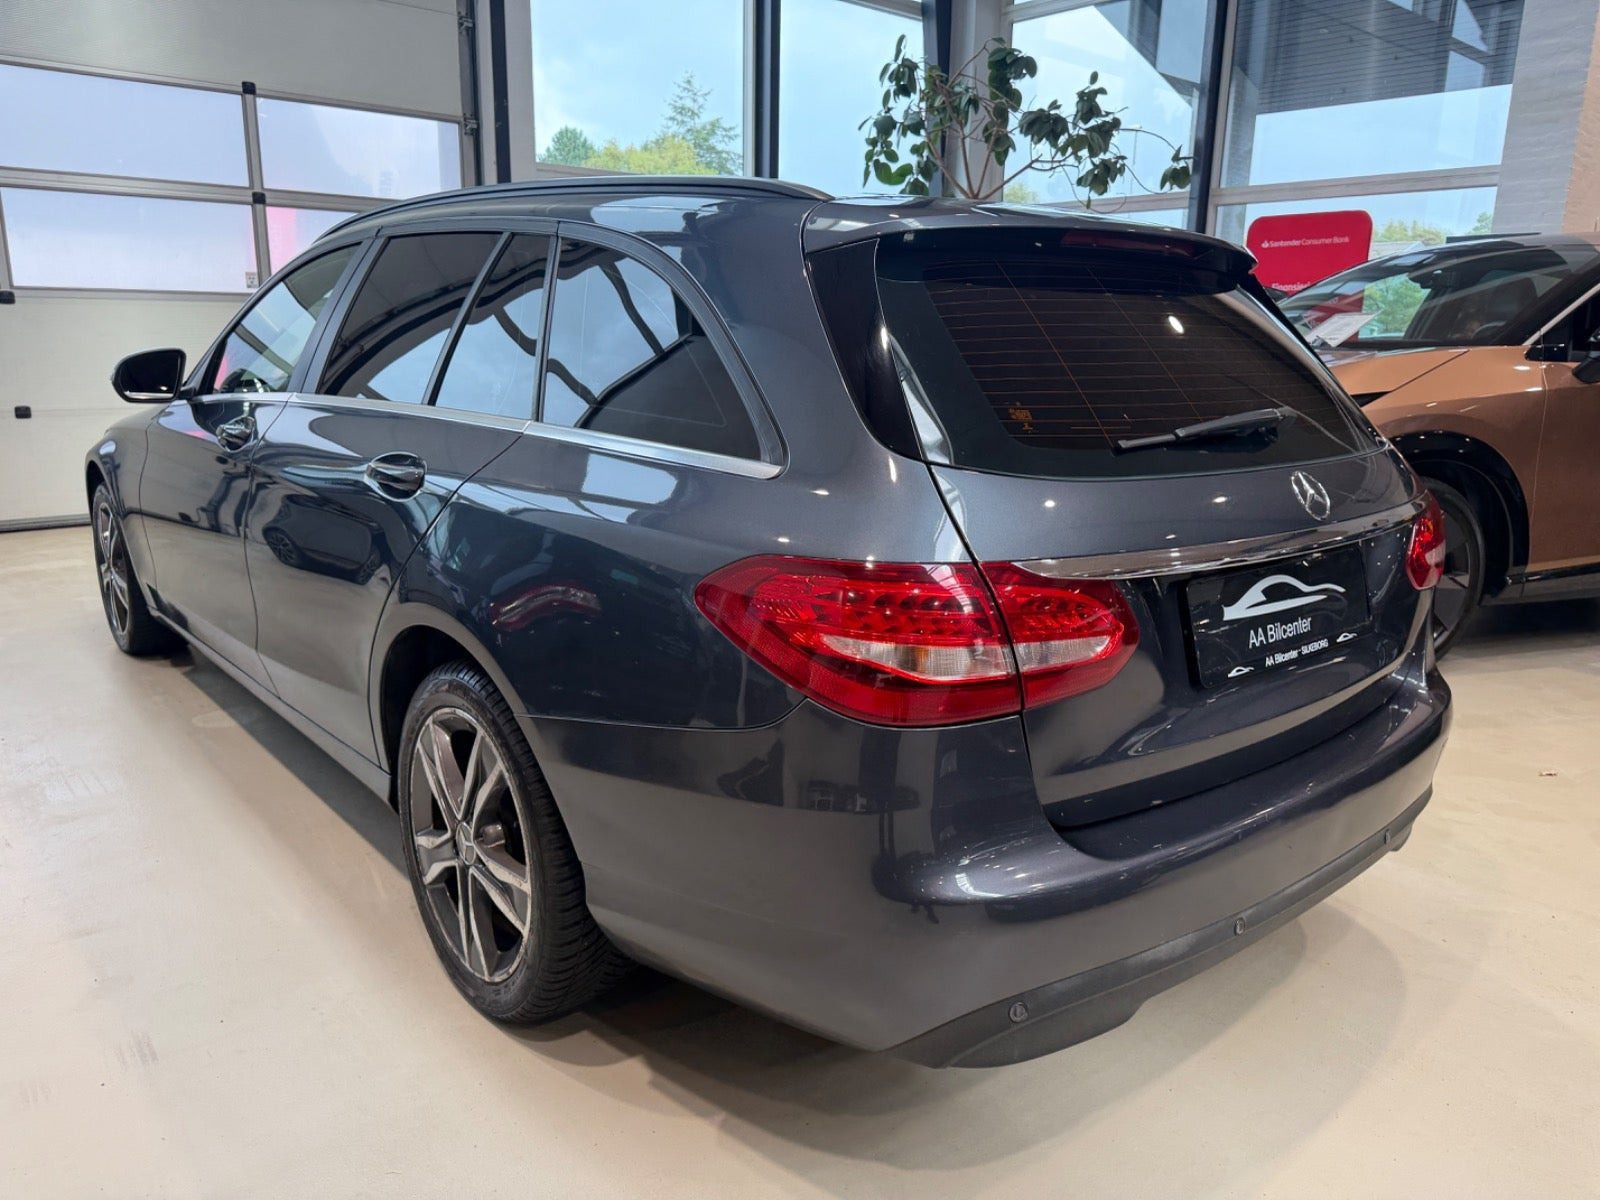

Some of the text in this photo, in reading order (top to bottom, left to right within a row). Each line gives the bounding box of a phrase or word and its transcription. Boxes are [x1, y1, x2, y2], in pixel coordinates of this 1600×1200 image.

[1269, 239, 1300, 247] Santander
[1248, 616, 1312, 649] AA Bilcenter
[1265, 655, 1275, 667] AA
[1274, 649, 1299, 664] Bilcenter
[1301, 639, 1329, 655] SILKEBORG
